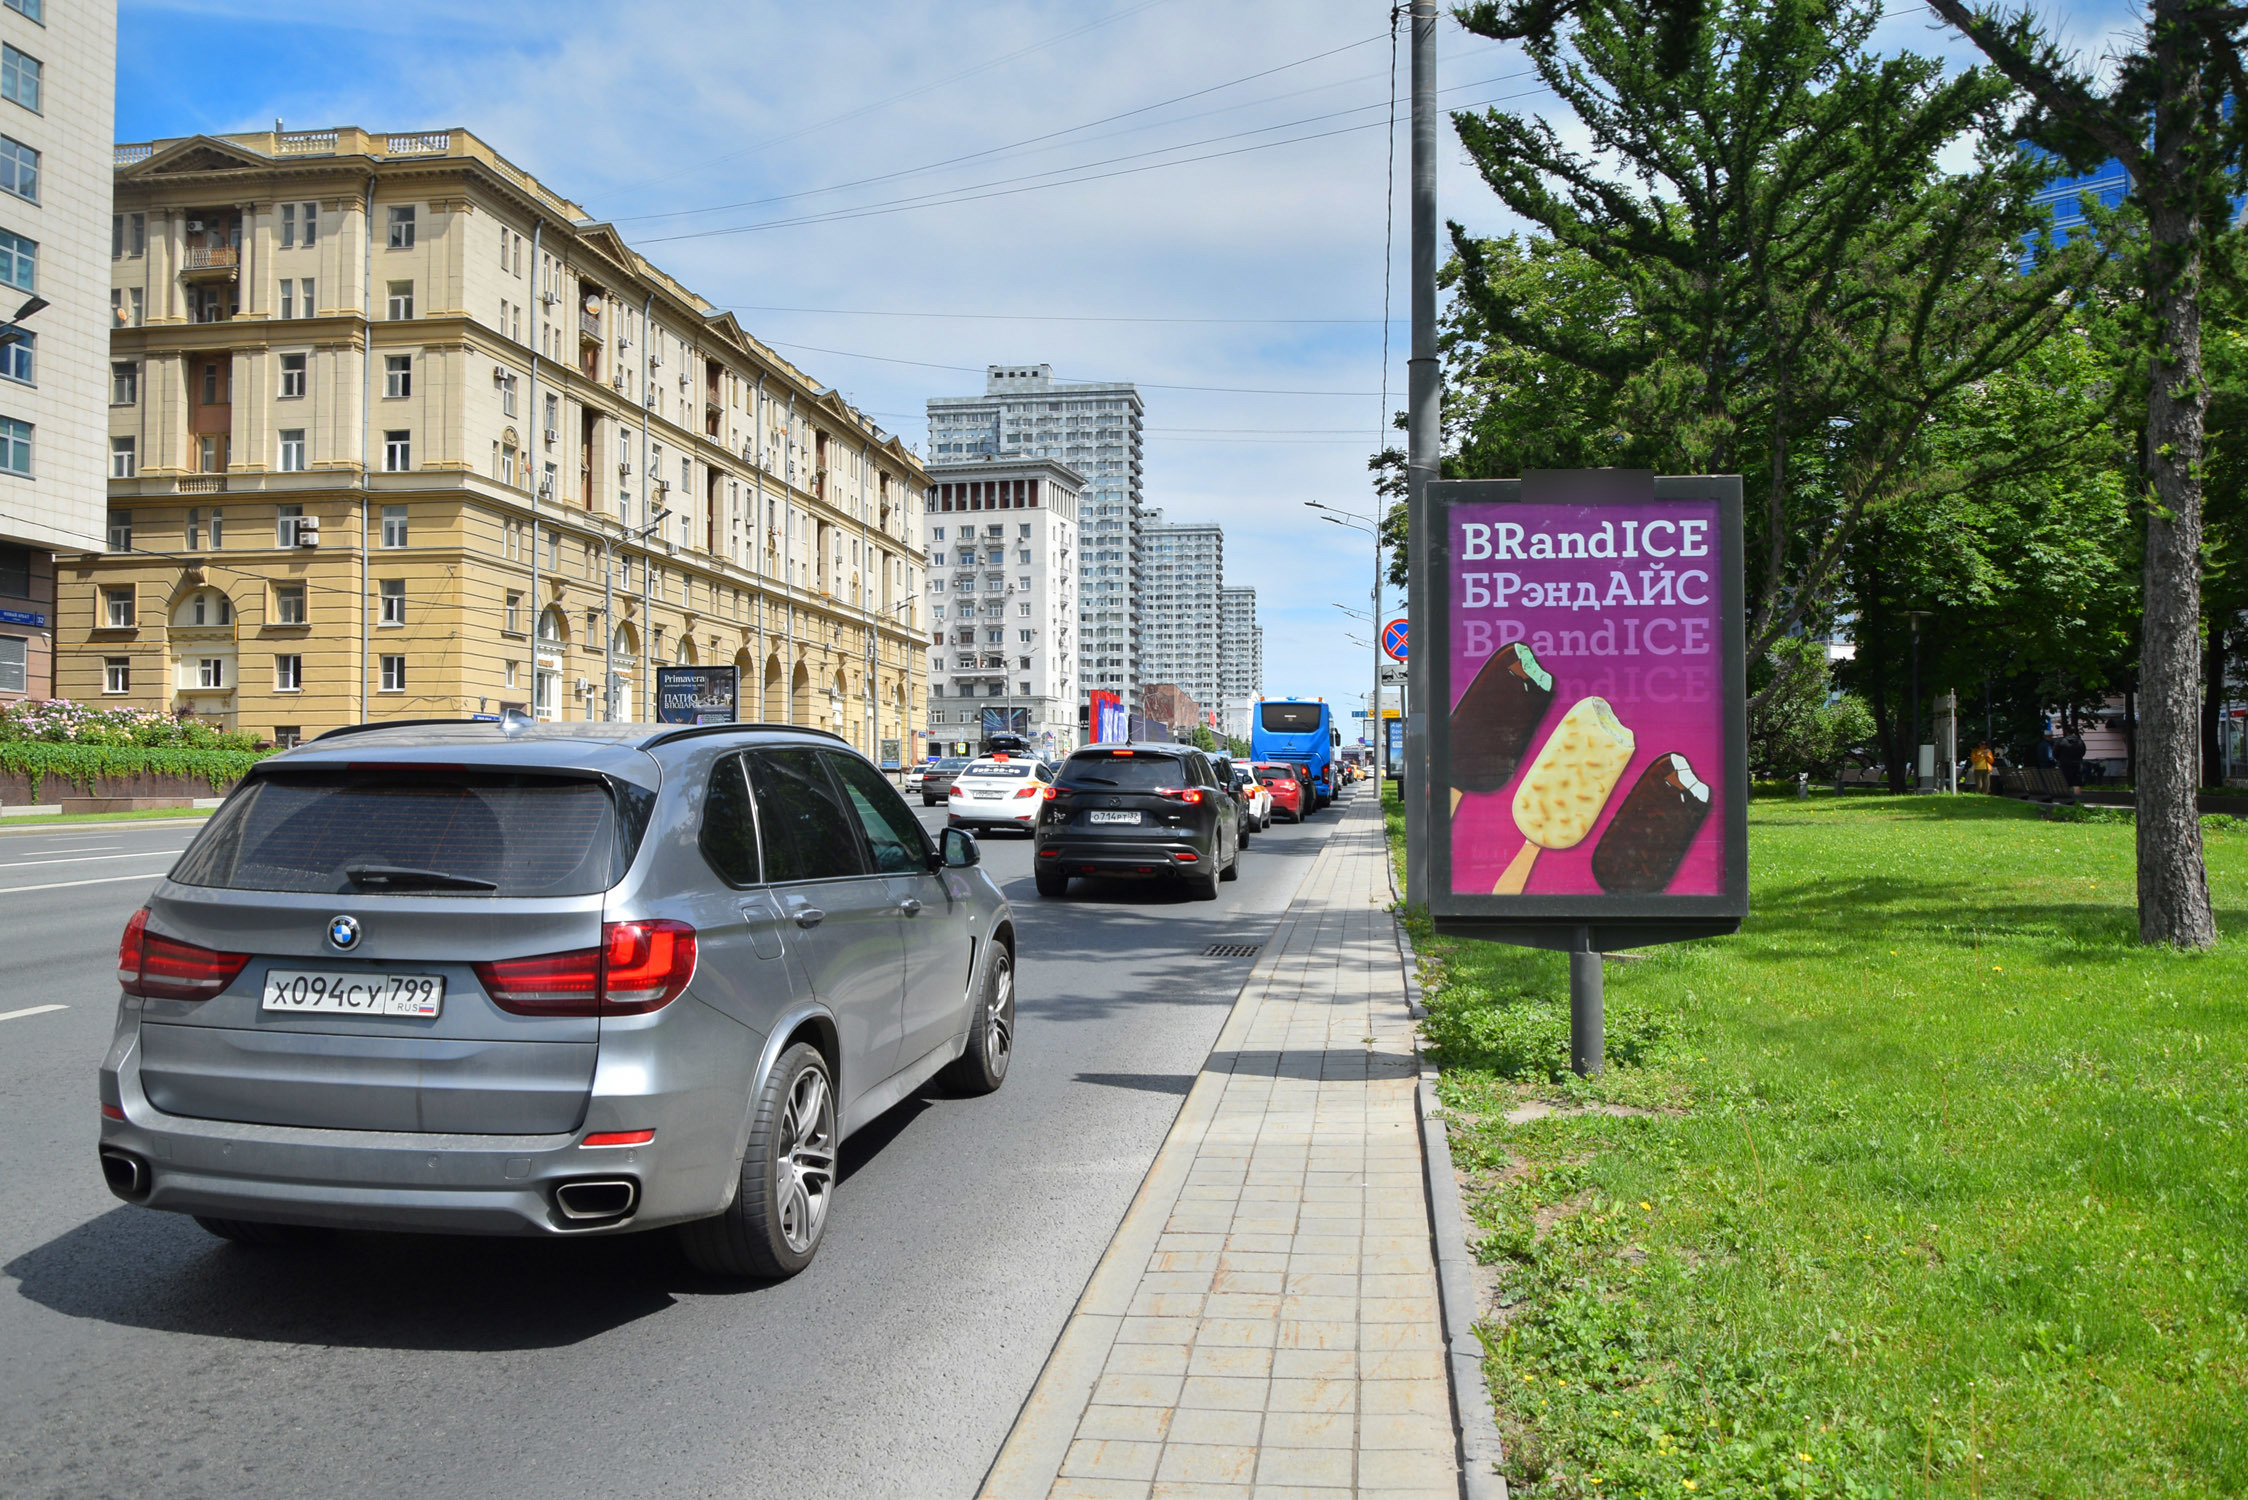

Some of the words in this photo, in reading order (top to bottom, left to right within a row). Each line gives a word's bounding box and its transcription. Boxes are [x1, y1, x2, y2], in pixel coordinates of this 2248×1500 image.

[1462, 519, 1709, 560] BRandICE
[1462, 562, 1710, 611] БРэндАЙС
[664, 675, 705, 684] Primavera
[664, 693, 698, 703] ПАТИО
[390, 978, 433, 1002] 799
[397, 1003, 418, 1012] RUS
